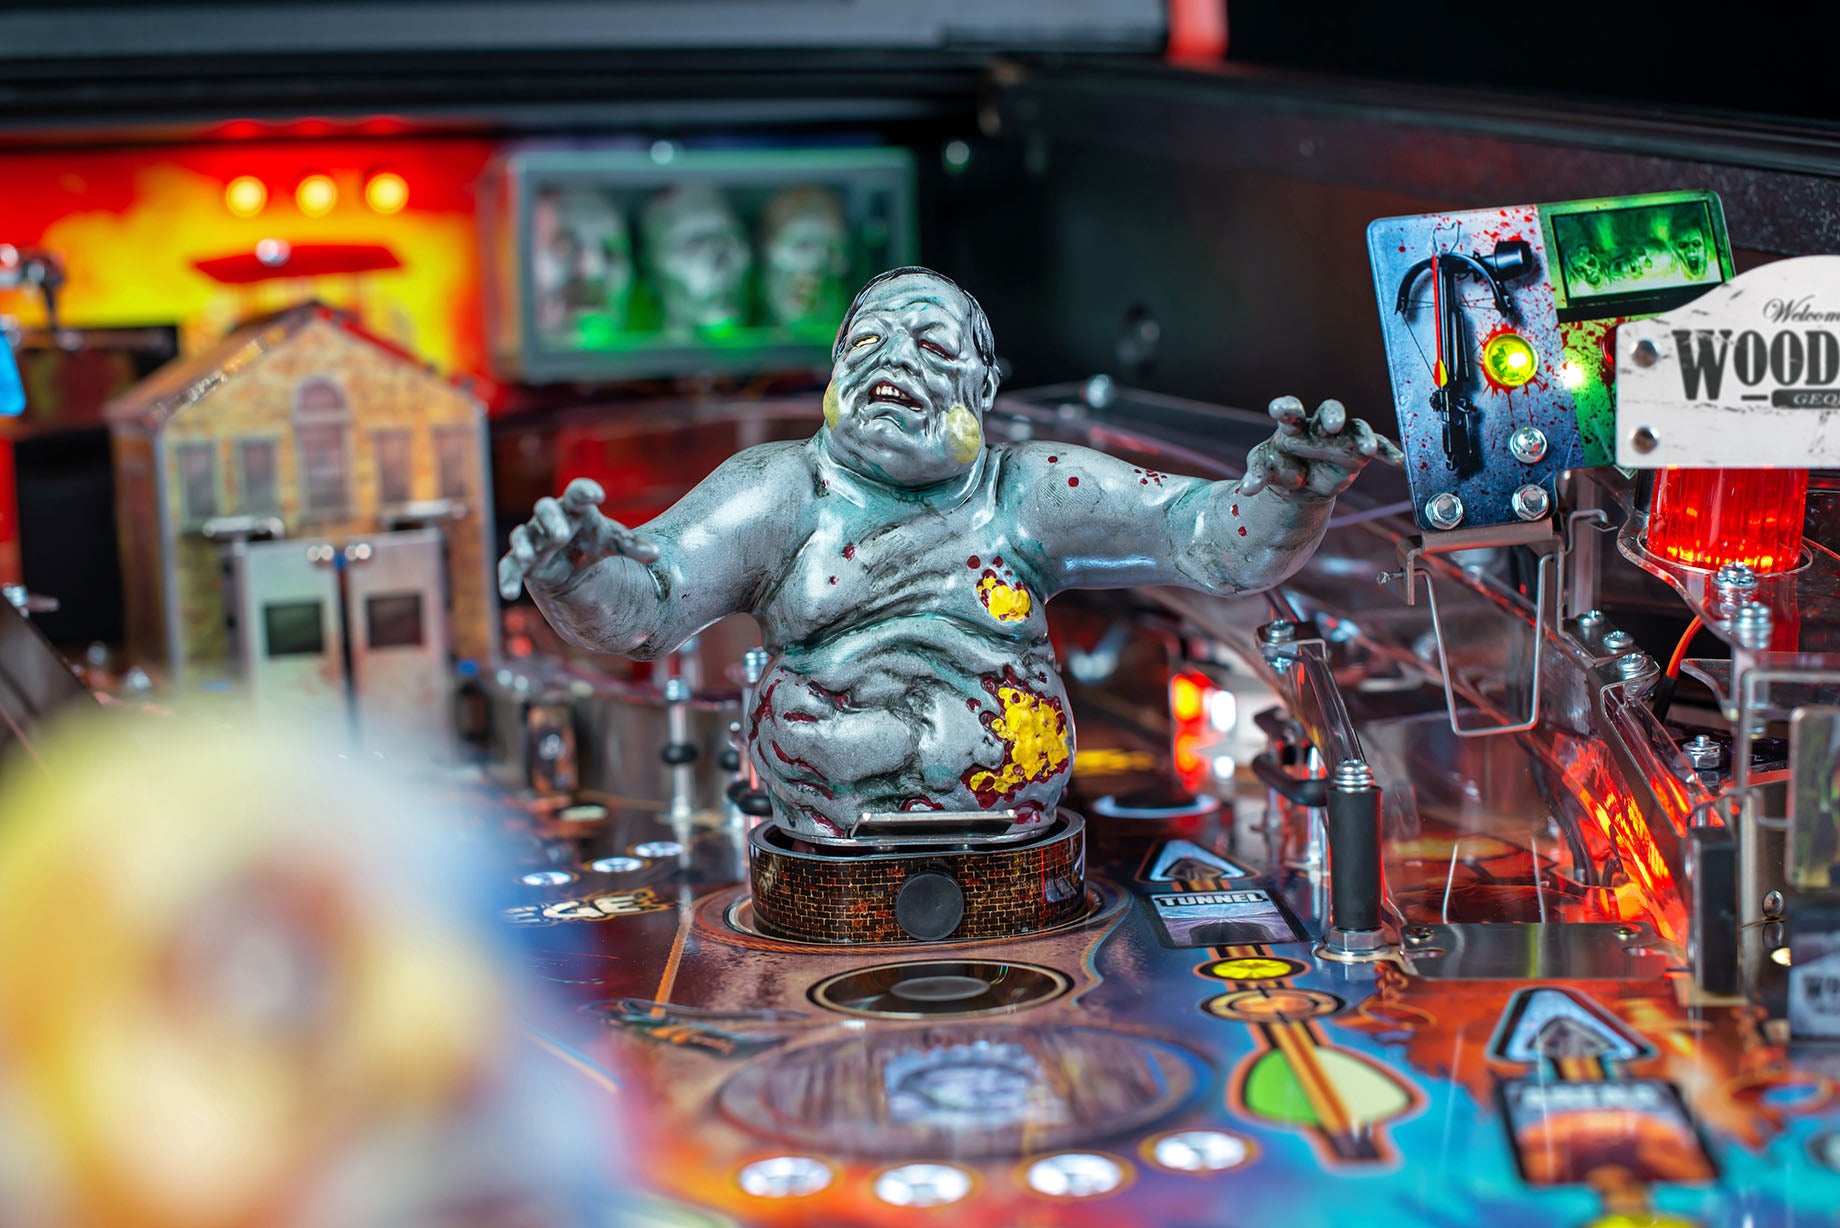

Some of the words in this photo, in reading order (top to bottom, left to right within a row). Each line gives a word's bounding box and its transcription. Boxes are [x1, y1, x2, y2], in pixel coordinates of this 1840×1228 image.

[1671, 329, 1840, 401] WOOD
[1793, 392, 1840, 406] GEO
[1159, 893, 1264, 906] TUNNEL
